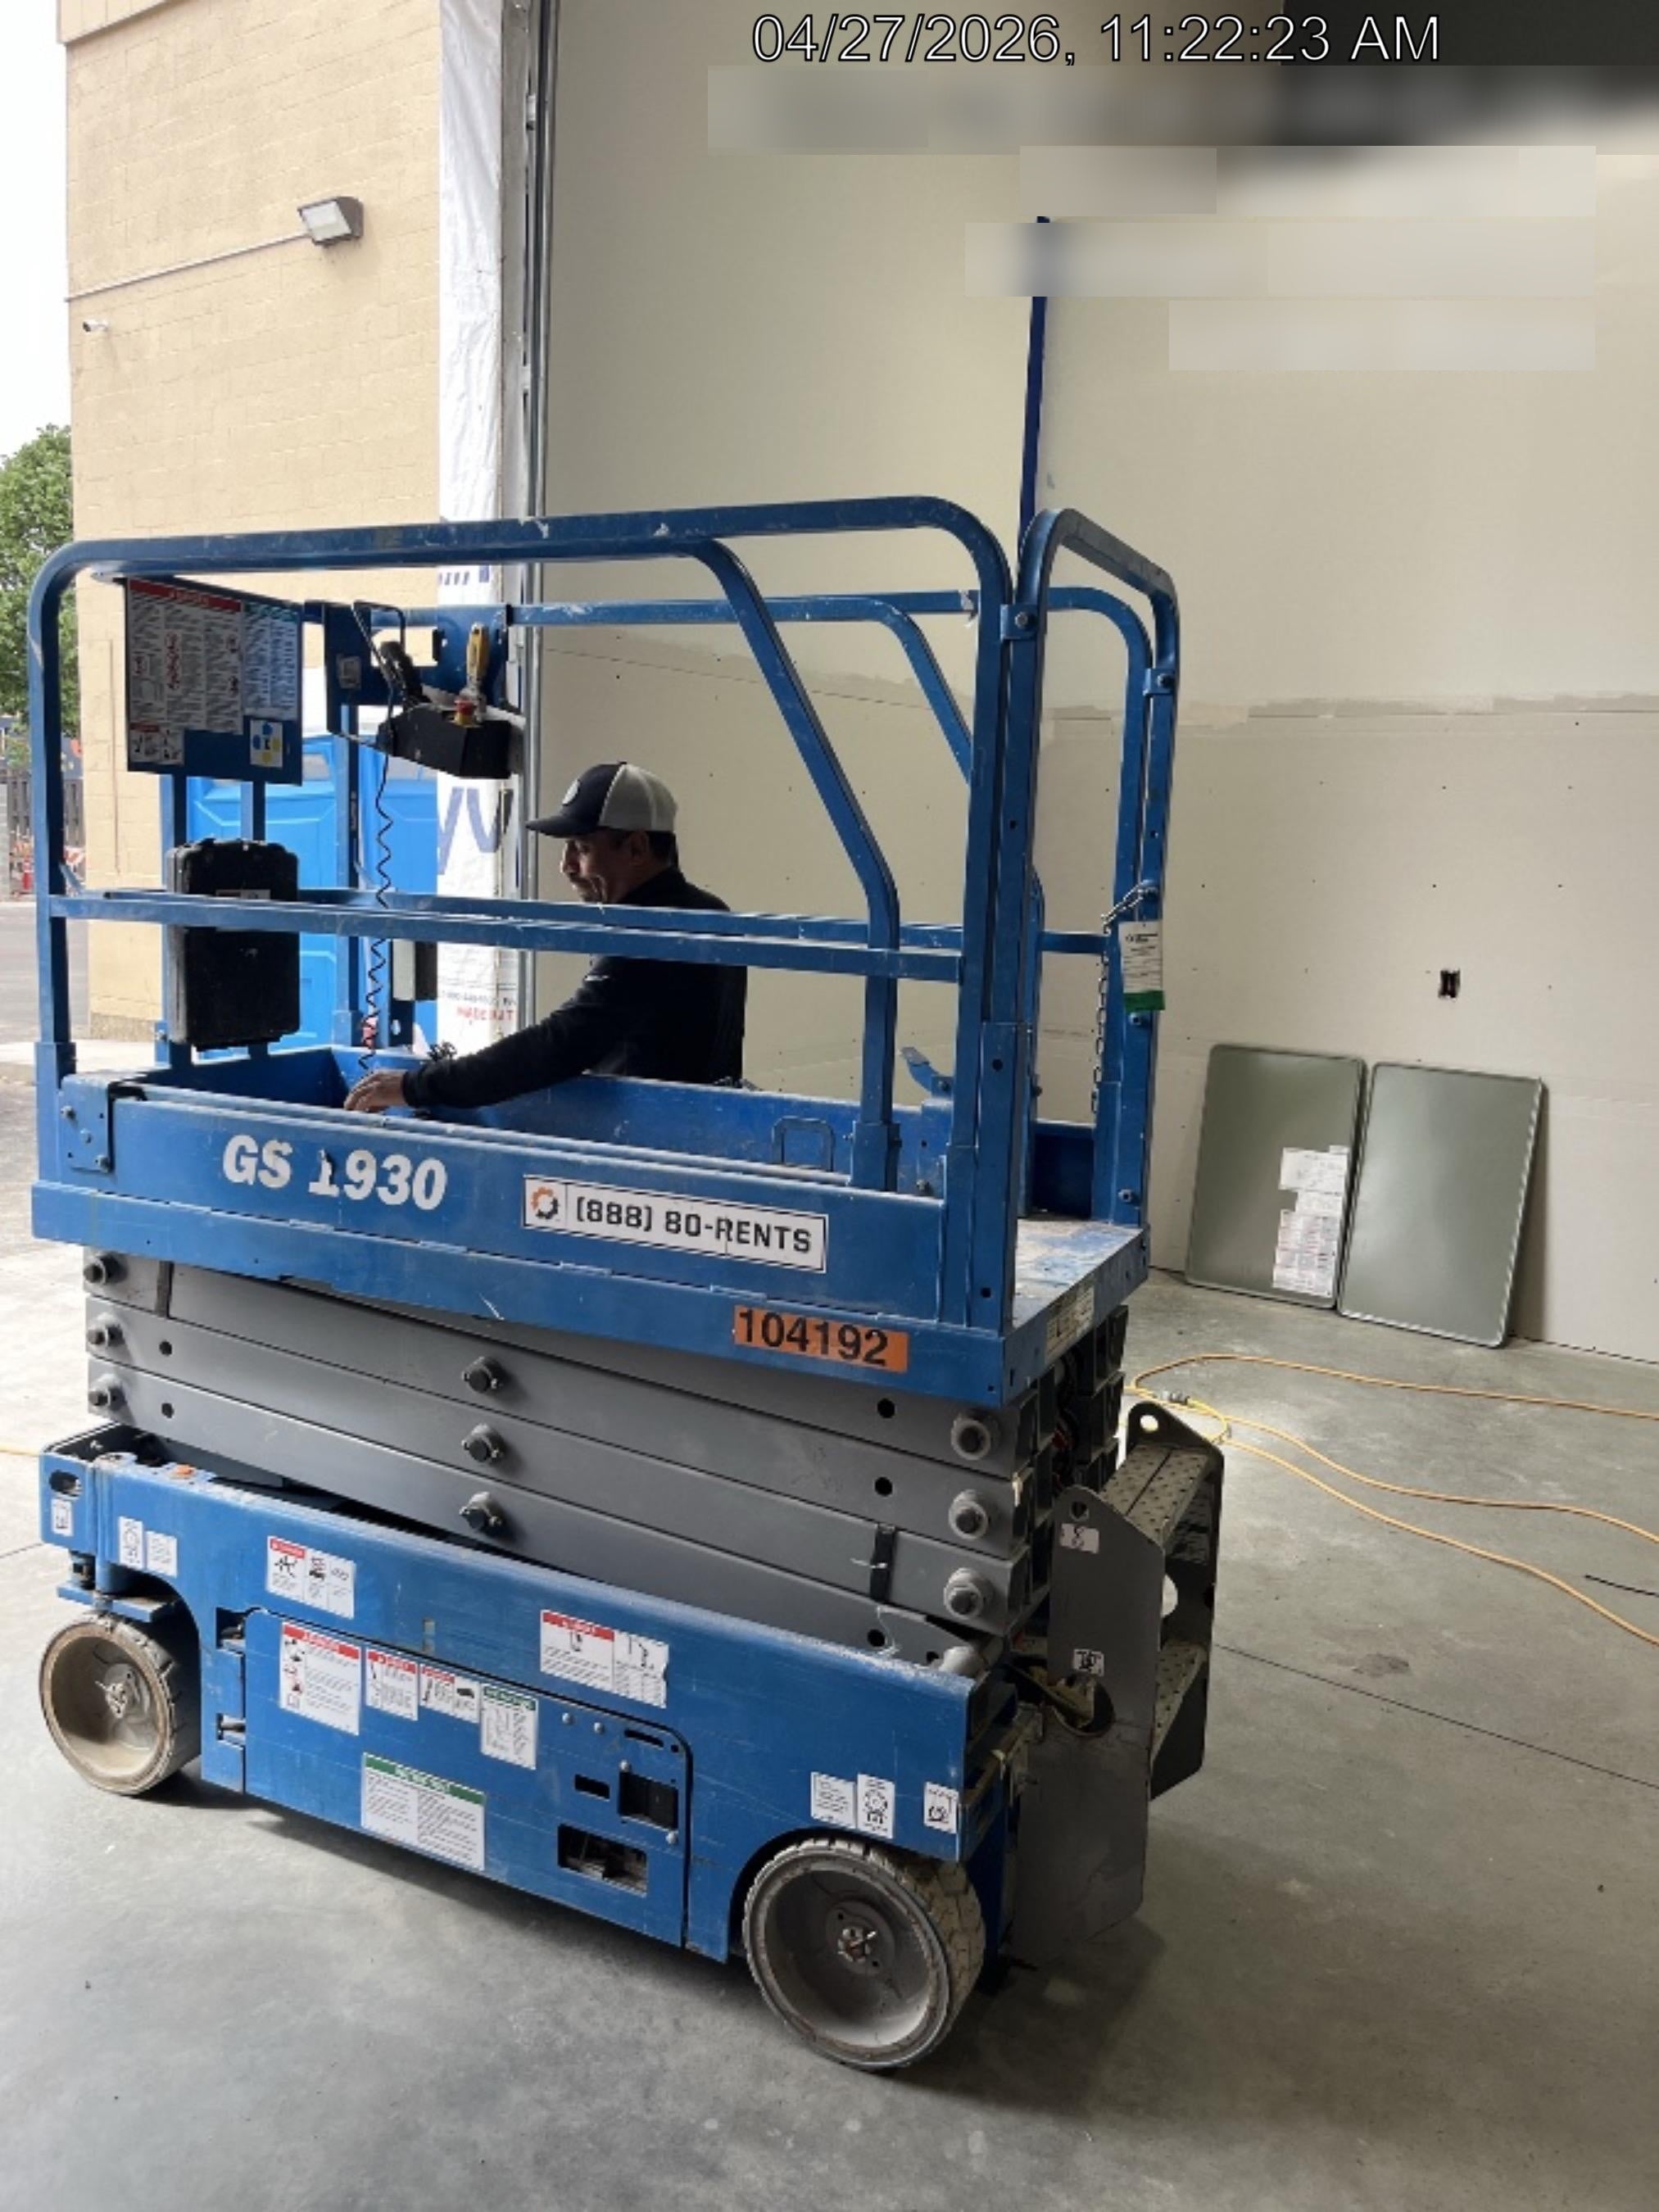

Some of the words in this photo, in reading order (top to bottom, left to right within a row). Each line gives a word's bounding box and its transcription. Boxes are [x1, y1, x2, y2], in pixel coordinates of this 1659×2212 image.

[222, 1134, 293, 1189] GS
[308, 1149, 448, 1211] 1930
[576, 1196, 653, 1232] (888)
[664, 1210, 812, 1253] 80-RENTS
[739, 1308, 889, 1367] 104192
